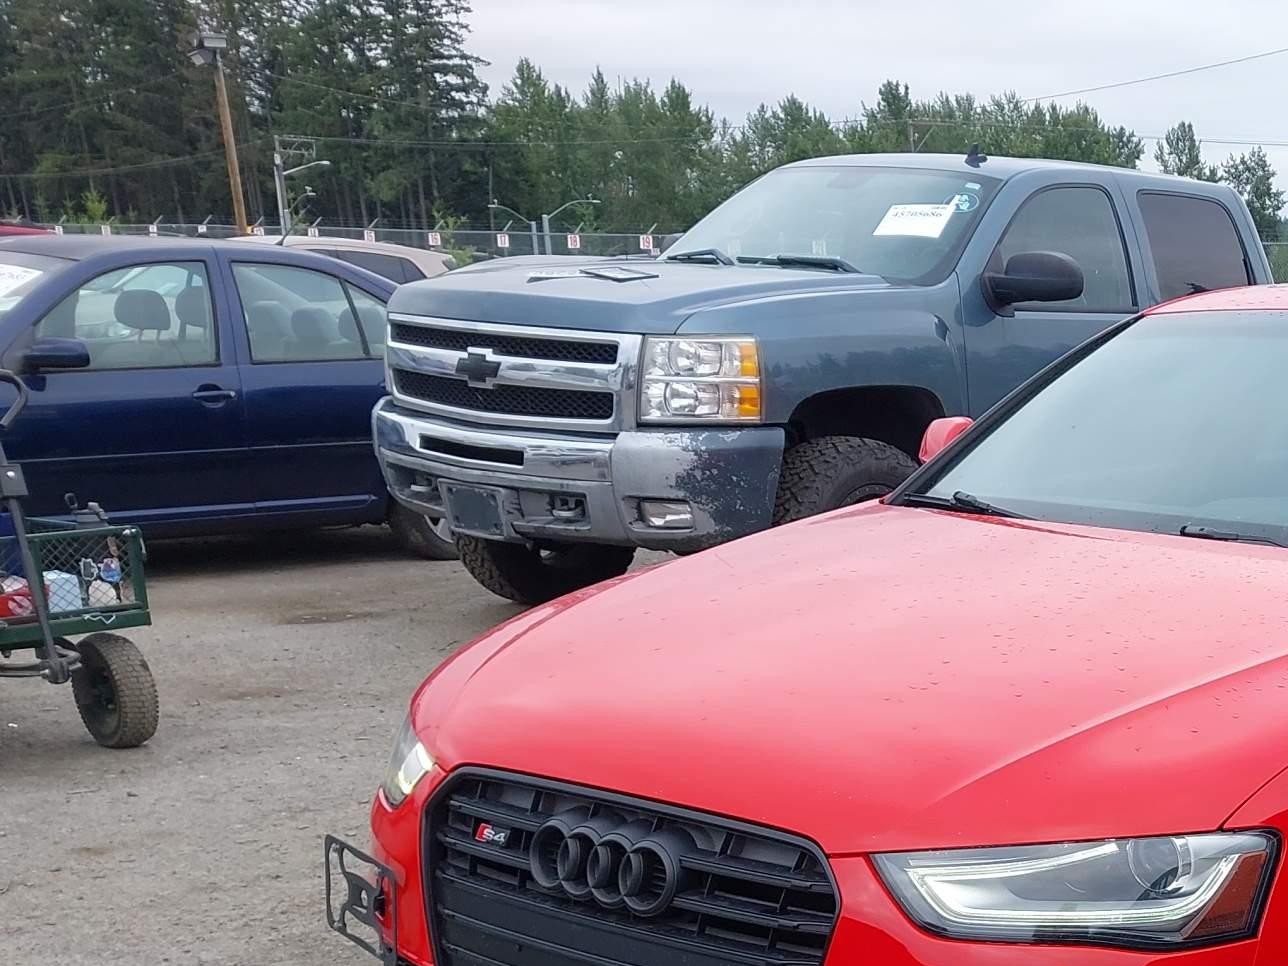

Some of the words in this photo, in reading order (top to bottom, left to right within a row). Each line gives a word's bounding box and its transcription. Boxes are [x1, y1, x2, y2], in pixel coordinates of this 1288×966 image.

[499, 235, 508, 247] 17
[570, 235, 579, 247] 18
[642, 236, 652, 248] 19
[482, 828, 505, 842] S4
